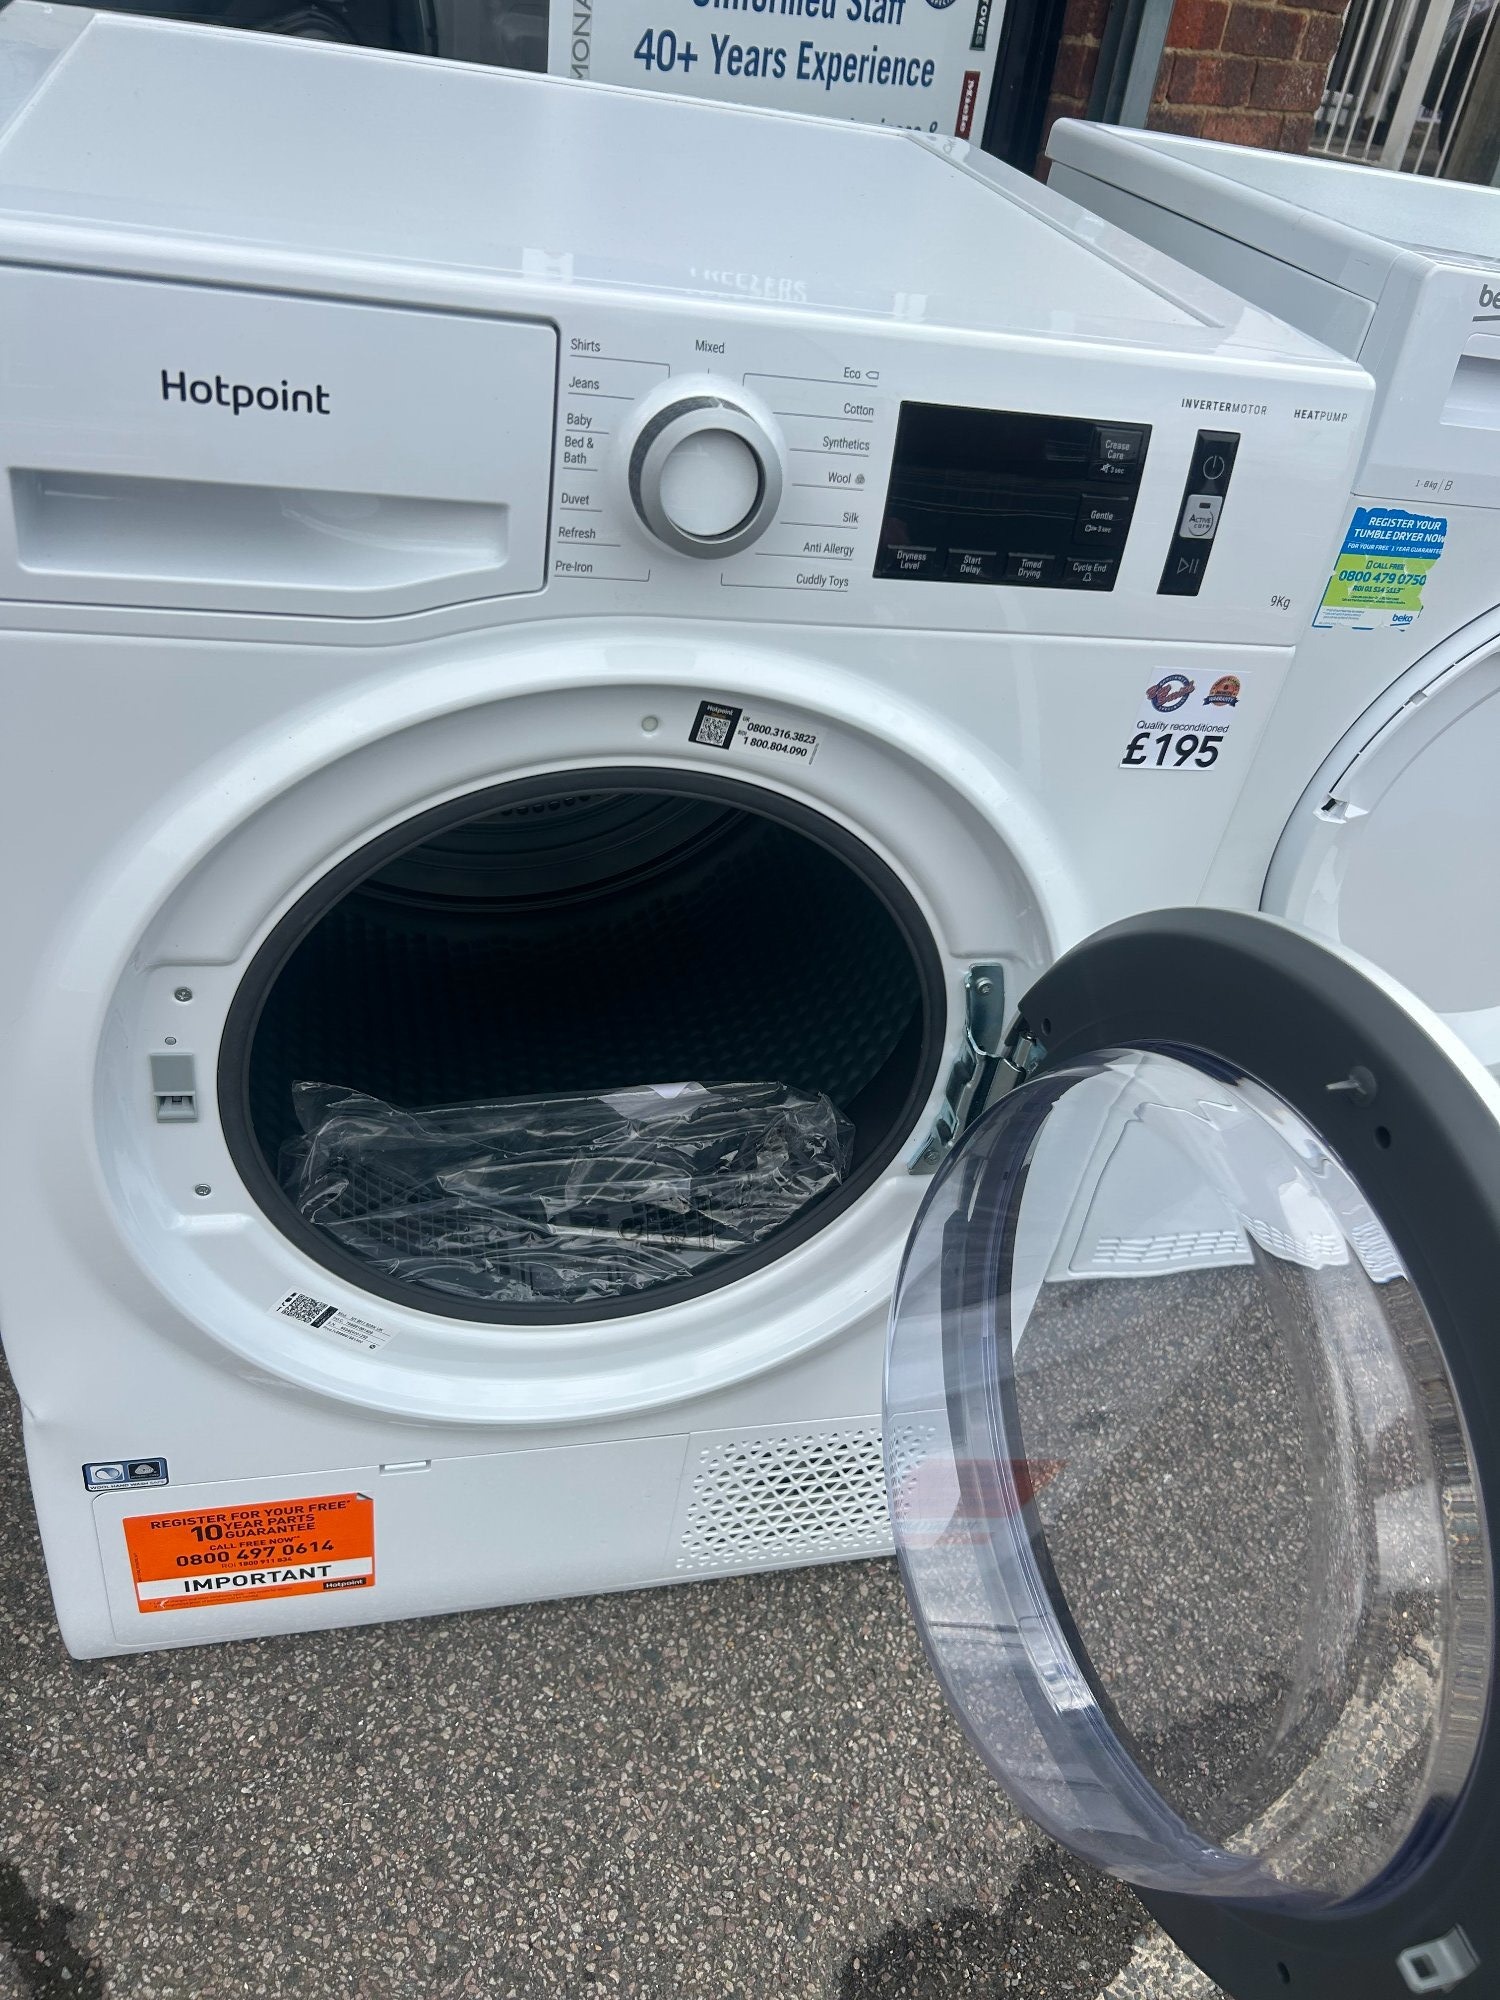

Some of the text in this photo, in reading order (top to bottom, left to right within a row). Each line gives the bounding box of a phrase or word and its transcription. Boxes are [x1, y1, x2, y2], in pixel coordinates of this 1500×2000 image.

[634, 28, 936, 91] 40+ Years Experience
[570, 338, 601, 352] Shirts
[695, 339, 725, 354] Mixed
[843, 367, 861, 380] Eco
[568, 376, 600, 391] Jeans
[161, 369, 330, 416] Hotpoint
[843, 403, 874, 417] Cotton
[566, 413, 592, 429] Baby
[564, 436, 594, 449] Bed &
[822, 436, 870, 452] Synthetics
[1105, 439, 1130, 451] Crease
[563, 452, 587, 465] Bath
[1107, 449, 1124, 460] Care
[828, 472, 851, 484] Wool
[561, 493, 590, 505] Duvet
[842, 512, 859, 524] Silk
[1090, 510, 1114, 520] Gentle
[1368, 517, 1441, 530] REGISTER YOUR
[558, 527, 596, 539] Refresh
[1354, 528, 1446, 543] TUMBLE DRYER NOW
[803, 542, 854, 557] Anti Allergy
[896, 550, 927, 561] Dryness
[900, 560, 921, 570] Level
[963, 554, 982, 565] Start
[1021, 559, 1042, 569] Timed
[555, 560, 593, 573] Pre-Iron
[959, 564, 981, 575] Delay
[1072, 562, 1107, 573] Cycle End
[1018, 568, 1042, 579] Drying
[1338, 570, 1427, 586] 0800 479 0750
[796, 574, 849, 588] Cuddly Toys
[1270, 595, 1291, 610] 9Kg
[1392, 613, 1413, 622] beko
[706, 705, 734, 716] Hotpoint
[747, 722, 816, 744] 0800.316.3823
[1136, 720, 1229, 733] Quality reconditioned
[749, 738, 808, 757] 800.804.090
[1121, 732, 1224, 768] £195
[150, 1515, 229, 1530] REGISTER
[231, 1510, 260, 1520] FOR
[264, 1506, 304, 1517] YOUR
[190, 1513, 315, 1542] 10 YEAR PARTS
[225, 1522, 315, 1539] GUARANTEE
[209, 1543, 237, 1551] CALL
[239, 1539, 268, 1548] FREE
[176, 1539, 334, 1568] 0800 497 0614
[184, 1564, 332, 1593] IMPORTANT
[325, 1579, 363, 1589] Hotpoint
